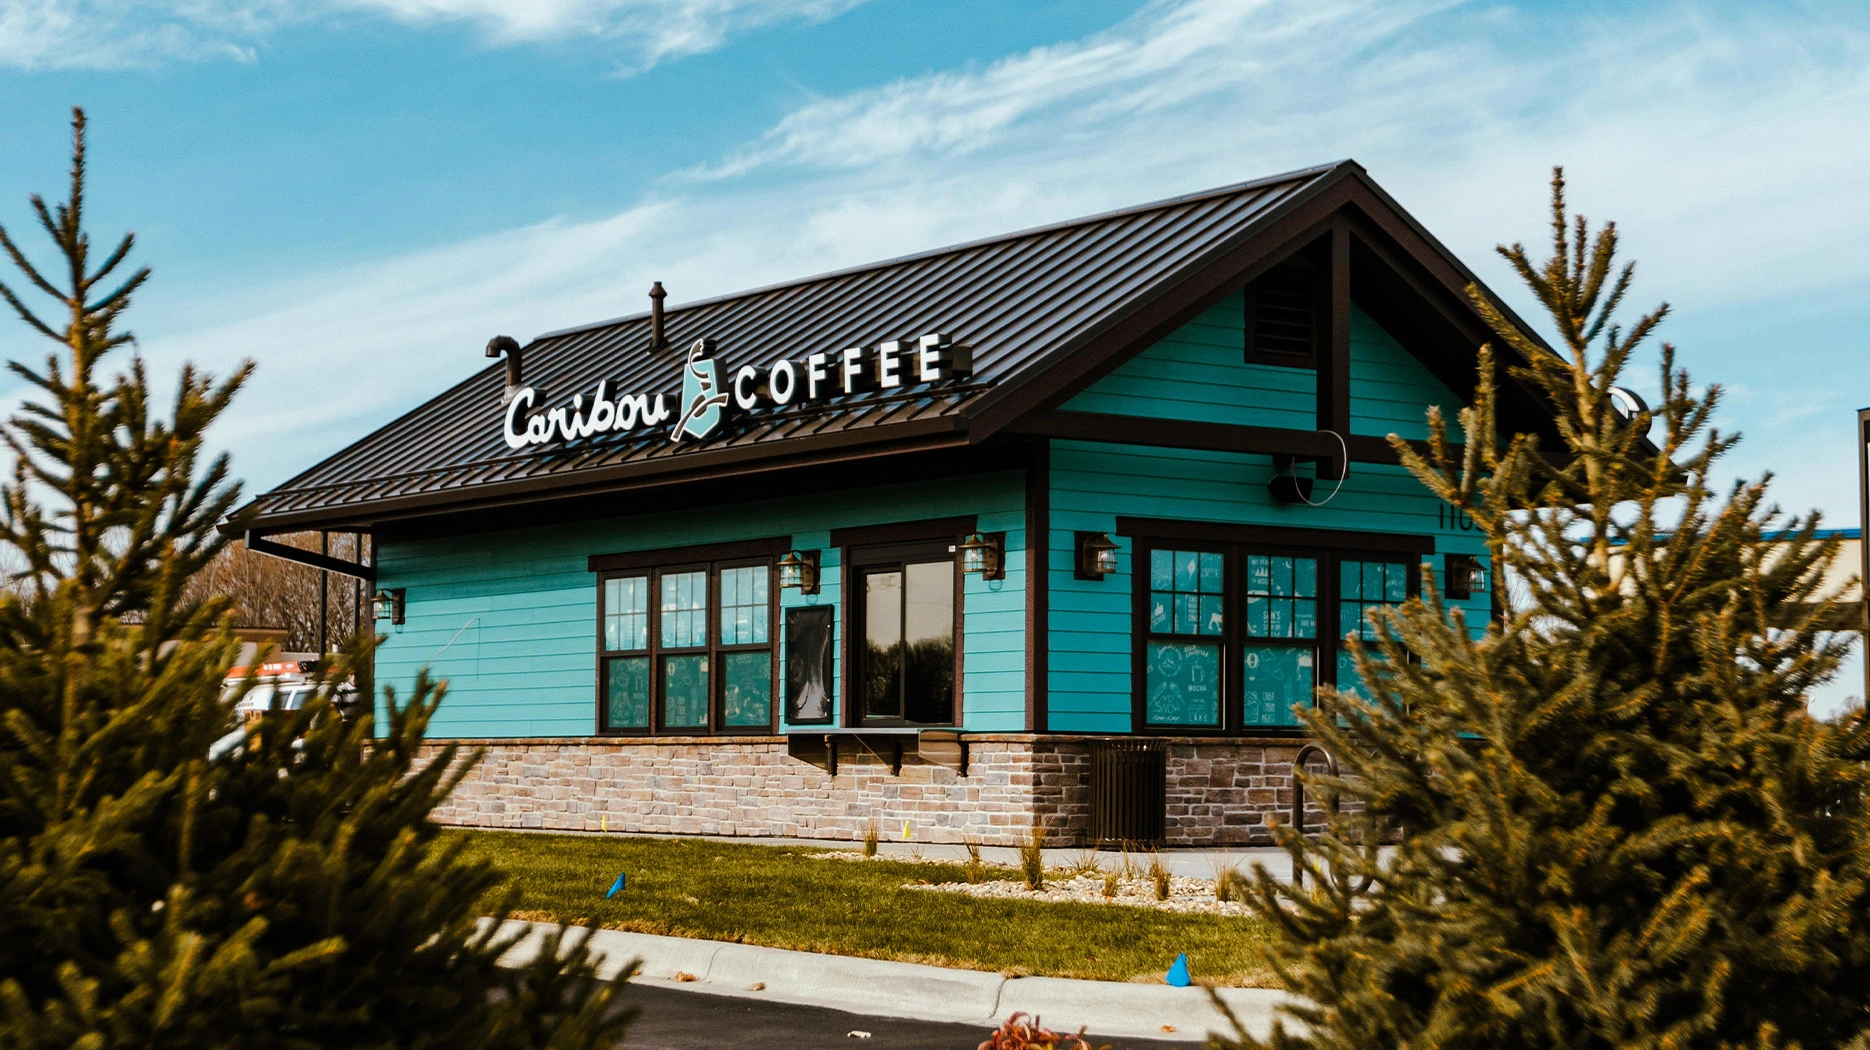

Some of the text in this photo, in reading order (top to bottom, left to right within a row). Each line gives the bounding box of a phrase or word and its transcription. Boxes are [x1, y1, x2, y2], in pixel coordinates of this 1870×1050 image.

[504, 333, 940, 448] Caribou COFFEE
[1439, 503, 1484, 531] 110
[1188, 684, 1207, 692] MOCHA
[1189, 713, 1208, 722] LAKE
